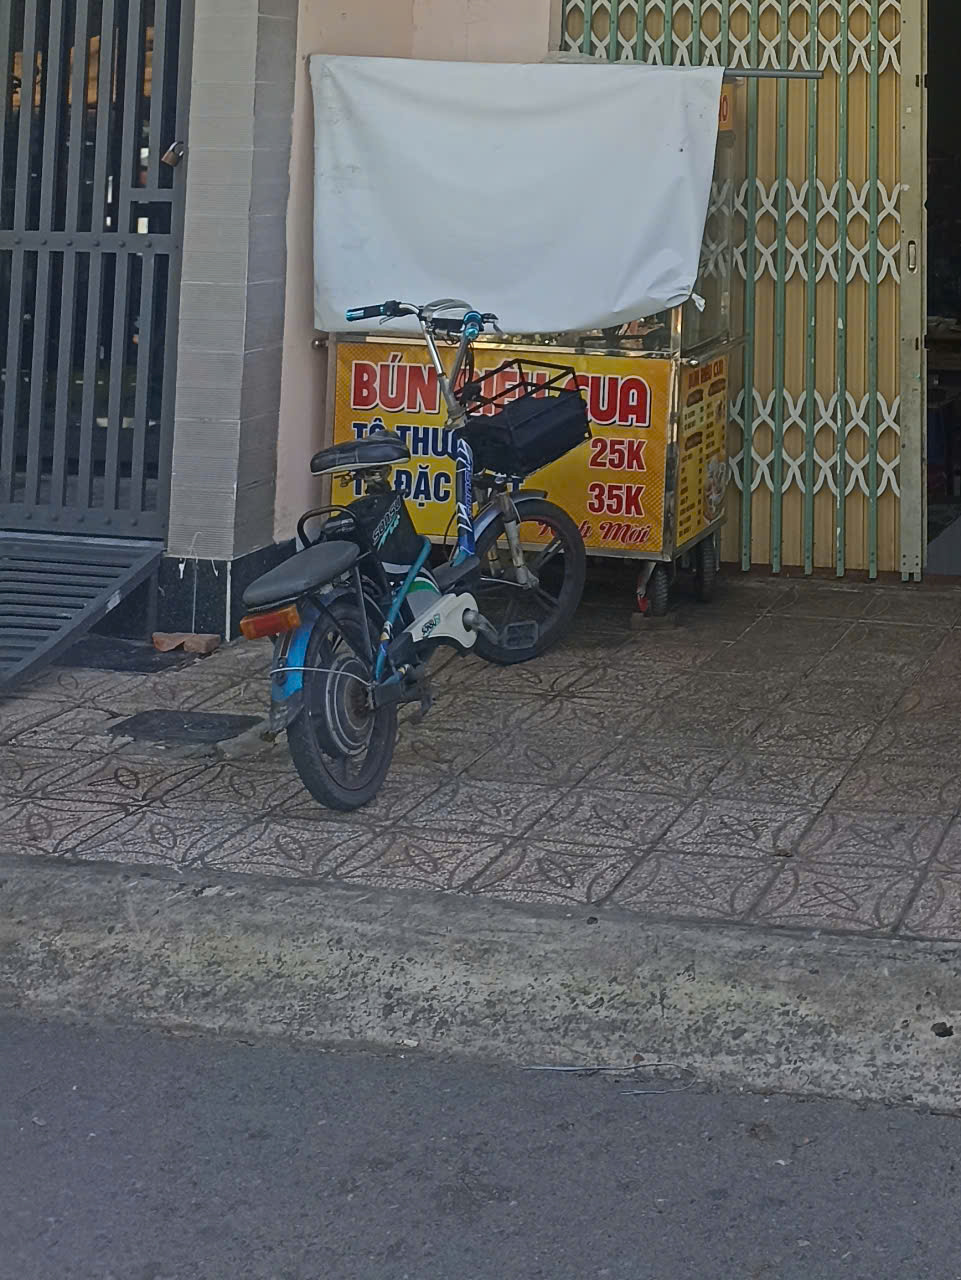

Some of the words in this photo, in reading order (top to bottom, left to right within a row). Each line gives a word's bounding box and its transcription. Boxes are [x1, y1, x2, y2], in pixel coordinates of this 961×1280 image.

[351, 352, 441, 415] BÚN
[589, 437, 647, 472] 25K
[587, 482, 647, 518] 35K
